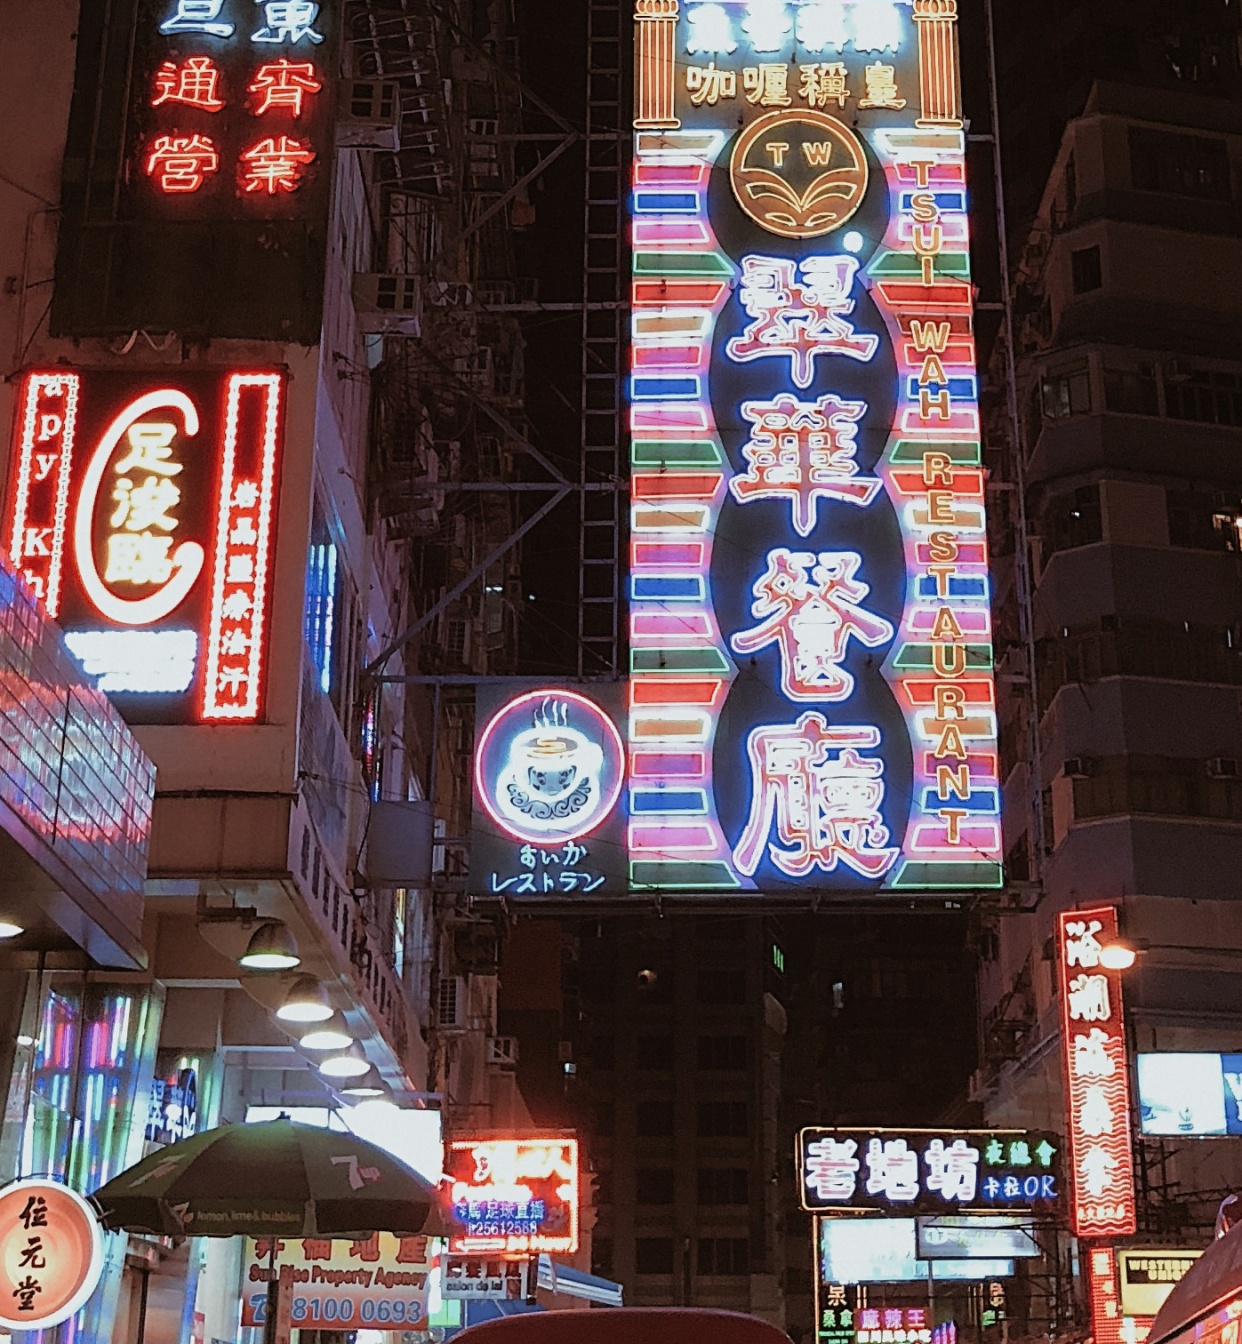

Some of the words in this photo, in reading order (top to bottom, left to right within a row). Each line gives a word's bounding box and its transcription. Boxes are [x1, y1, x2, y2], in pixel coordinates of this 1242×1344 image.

[910, 160, 943, 286] TSUI
[910, 320, 951, 420] WAH
[726, 255, 901, 878] 翠華餐廳
[922, 451, 972, 844] RESTAURANT
[12, 1196, 48, 1311] 位元堂
[291, 1297, 354, 1322] 8100
[361, 1299, 422, 1324] 0693
[312, 1265, 373, 1288] Property
[374, 1267, 428, 1290] Agency
